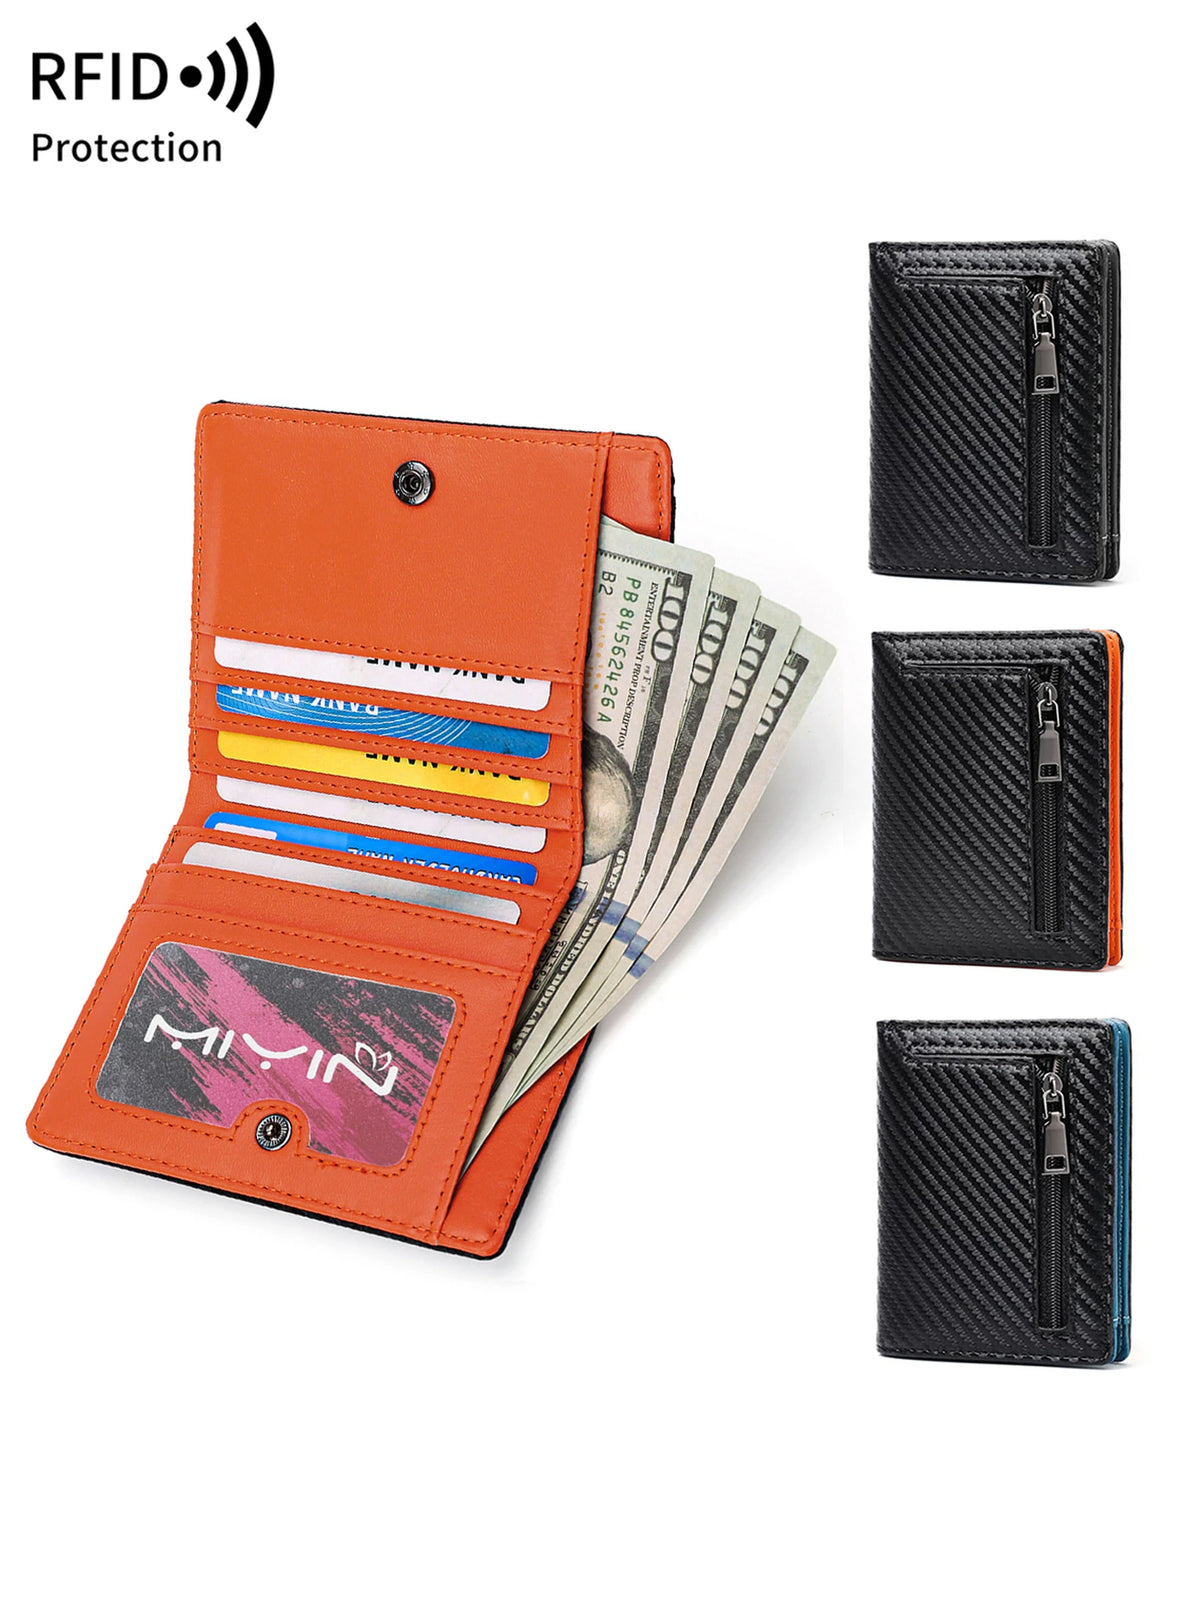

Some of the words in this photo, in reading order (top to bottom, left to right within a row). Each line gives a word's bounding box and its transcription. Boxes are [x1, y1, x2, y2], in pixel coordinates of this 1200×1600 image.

[598, 570, 617, 597] B2
[636, 582, 659, 660] ENTERTAINMENT
[651, 576, 685, 662] 100
[630, 662, 643, 690] PROP
[690, 600, 729, 685] 100
[725, 632, 766, 710] 100
[616, 688, 637, 750] DESCRIPTION
